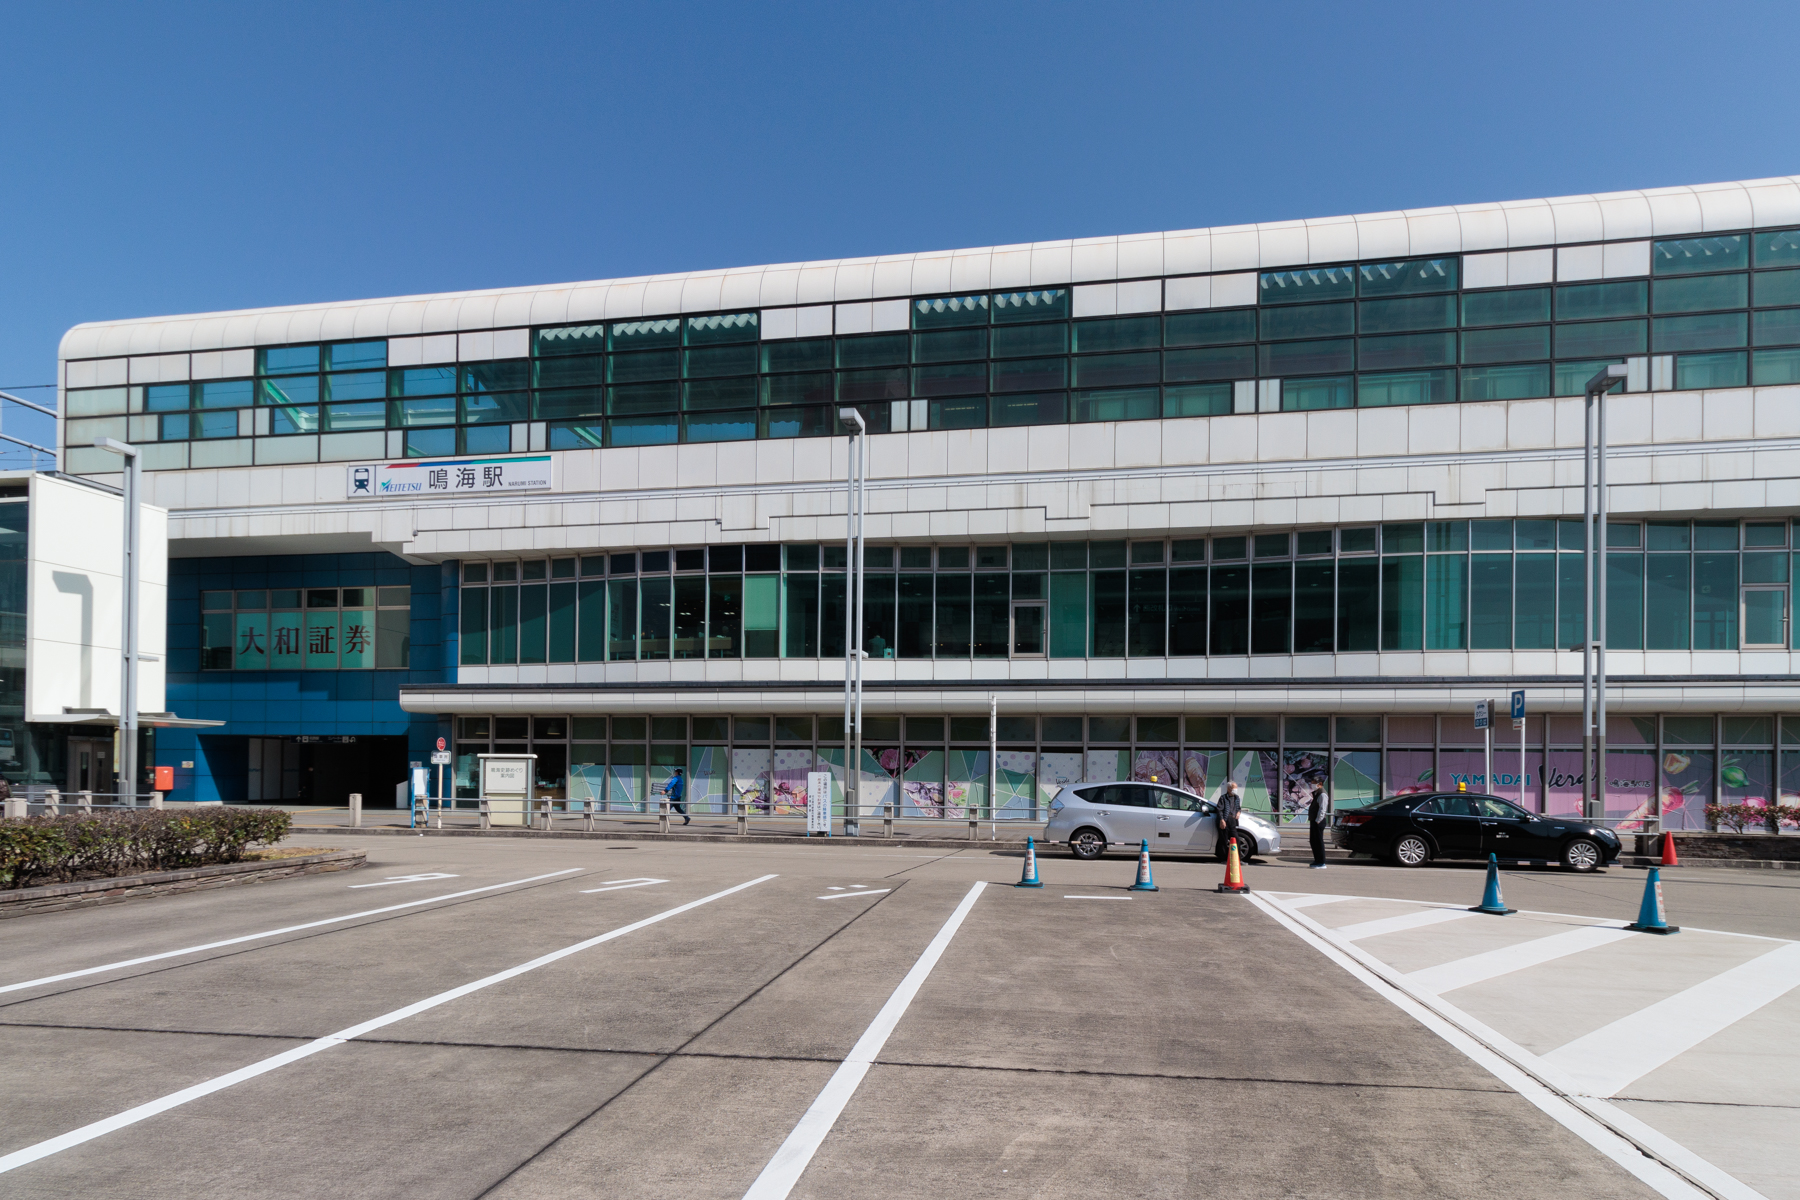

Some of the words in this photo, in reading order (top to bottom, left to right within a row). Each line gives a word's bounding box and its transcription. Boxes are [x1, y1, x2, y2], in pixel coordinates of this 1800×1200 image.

[429, 466, 503, 490] 鳴海駅
[239, 625, 371, 655] 大和証券
[1514, 693, 1523, 717] P
